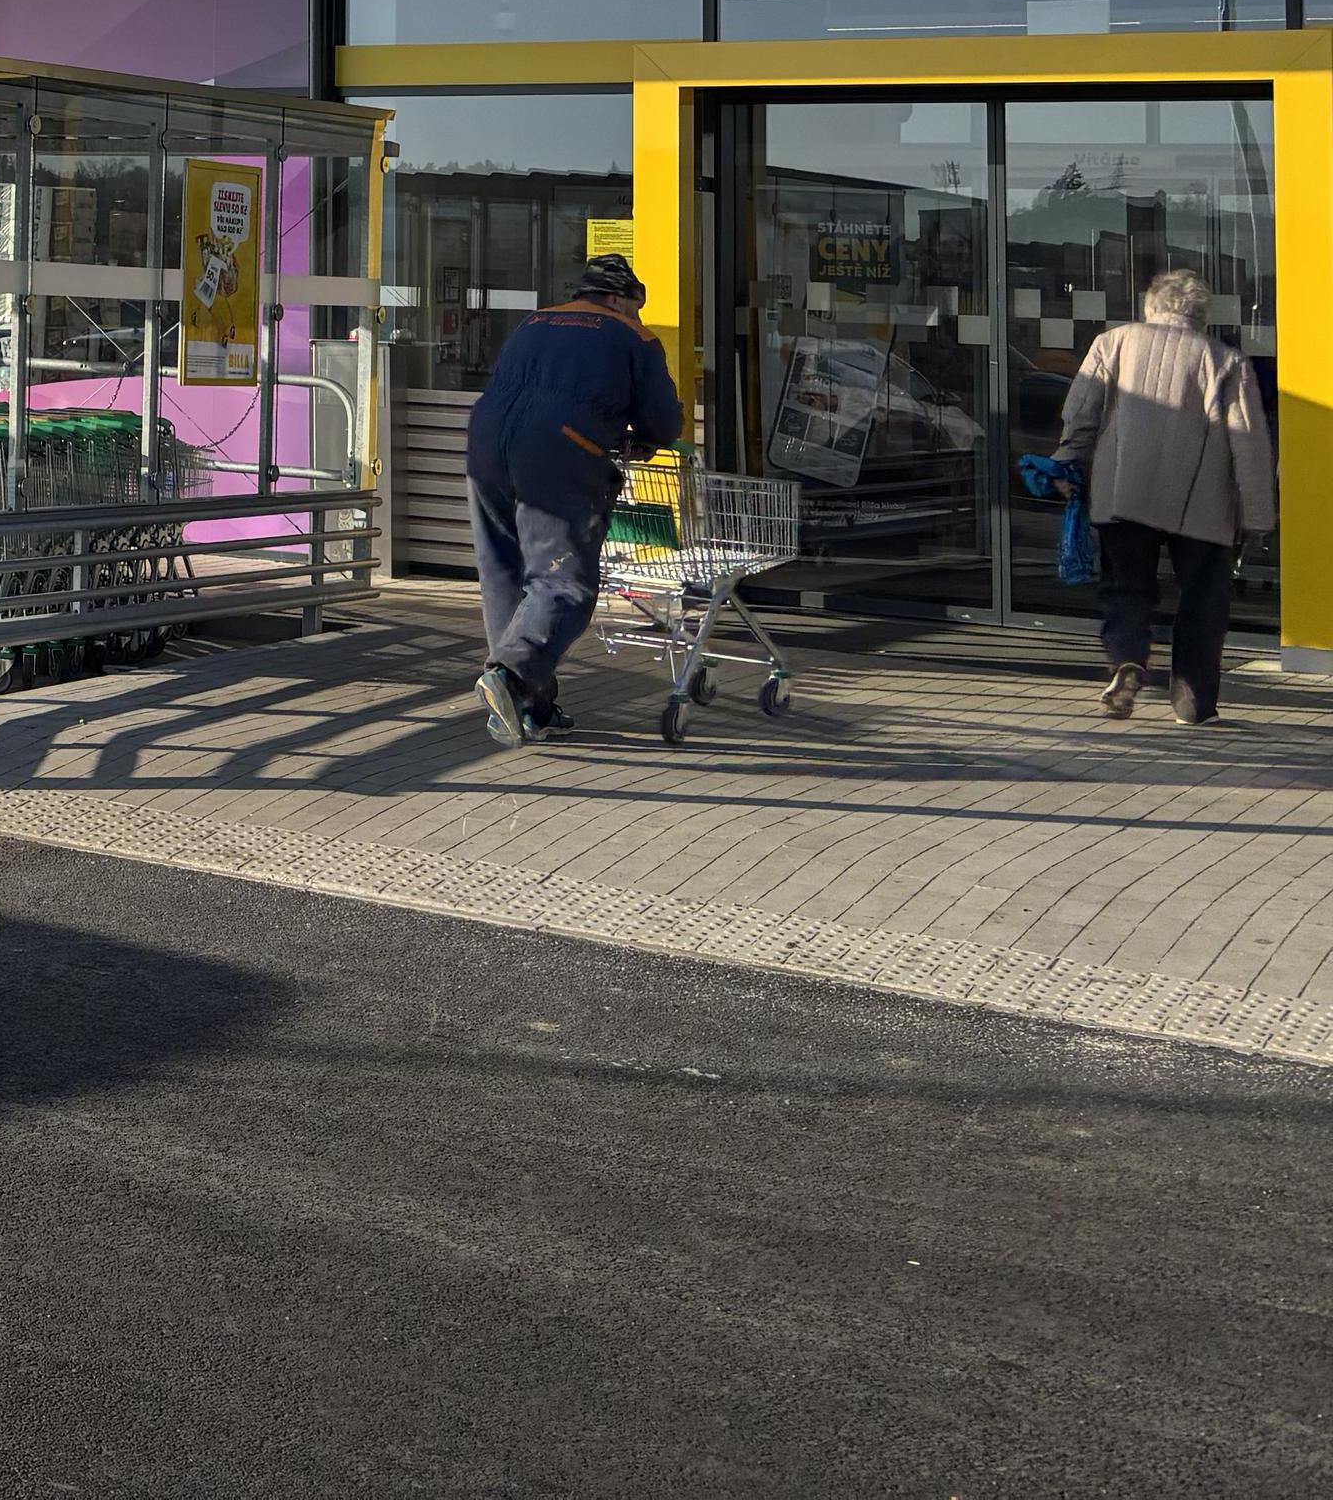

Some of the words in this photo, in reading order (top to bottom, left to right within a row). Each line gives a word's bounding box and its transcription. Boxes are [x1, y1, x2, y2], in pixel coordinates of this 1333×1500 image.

[817, 220, 892, 235] STÁHNĚTE
[818, 237, 890, 261] CENY
[819, 262, 863, 277] JEŠTĚ
